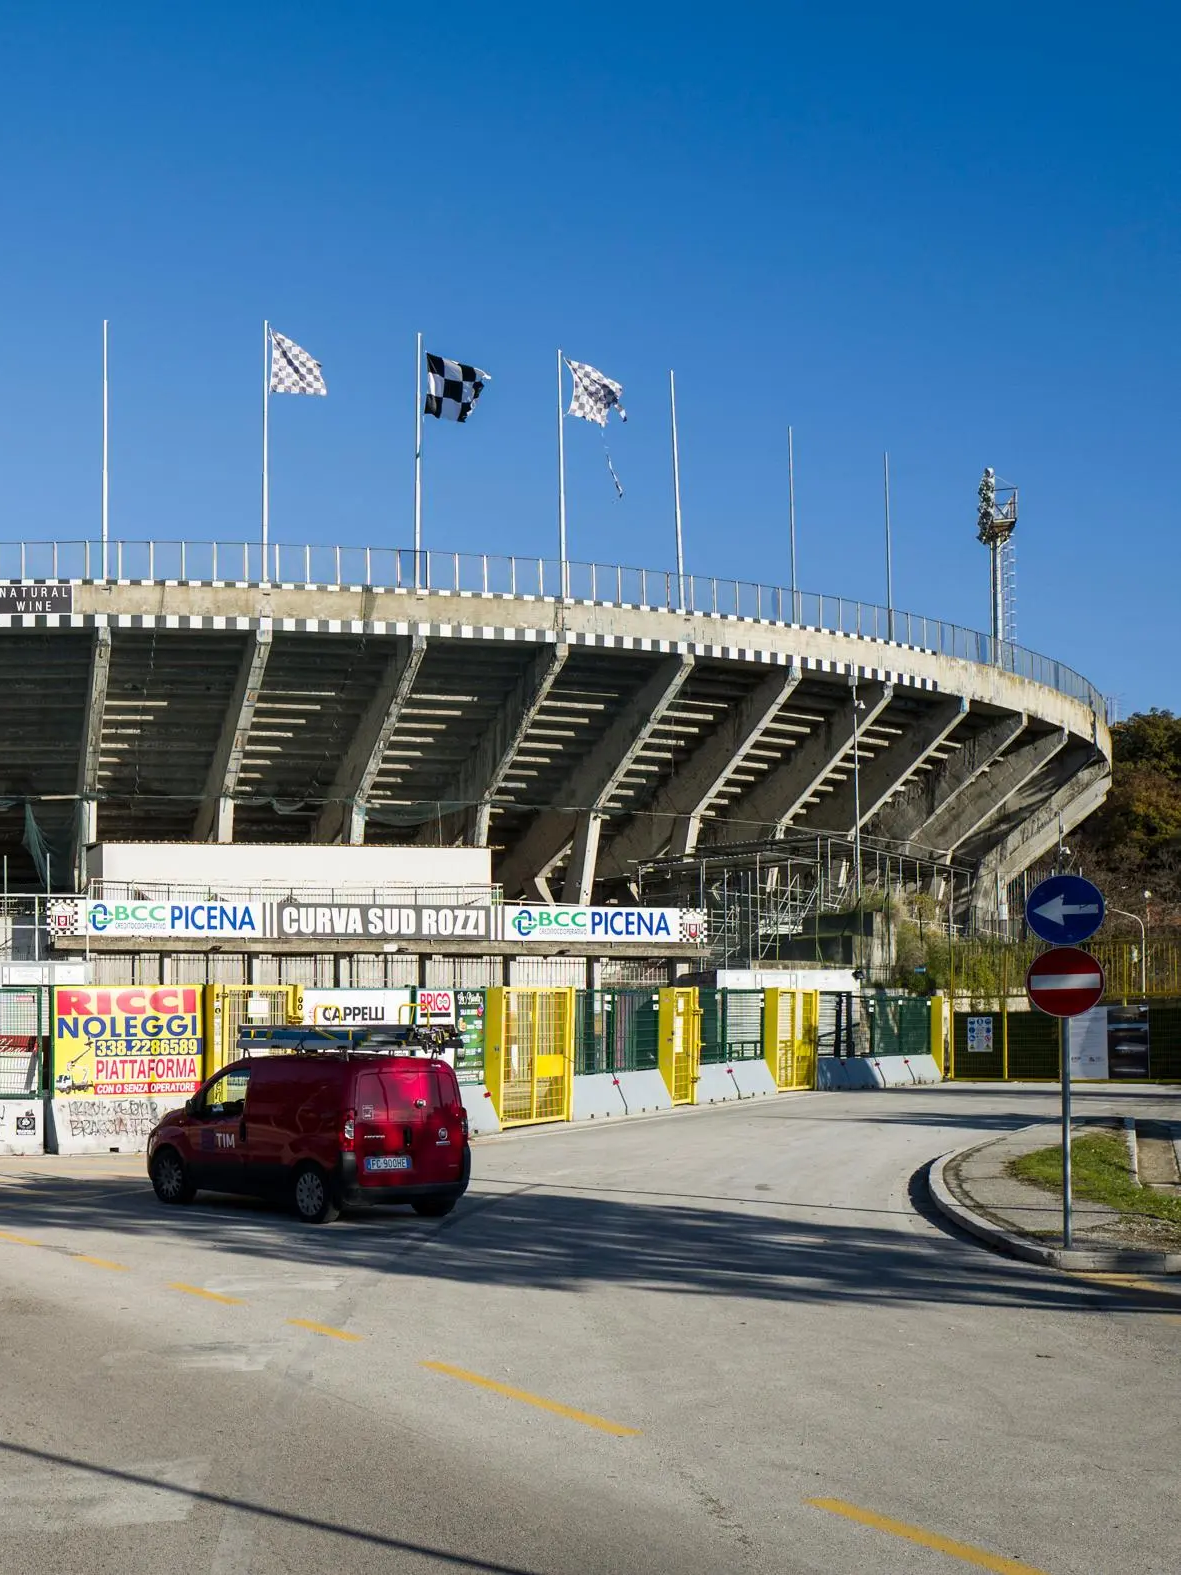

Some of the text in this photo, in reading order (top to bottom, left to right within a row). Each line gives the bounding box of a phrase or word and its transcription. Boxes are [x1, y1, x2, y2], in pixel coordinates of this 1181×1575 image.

[0, 587, 68, 598] NATURAL
[16, 600, 52, 612] WINE
[114, 905, 256, 931] BCC PICENA
[282, 906, 486, 936] CURVA SUD ROZZI
[538, 911, 671, 936] BCC PICENA
[57, 989, 197, 1016] RICCI
[420, 992, 451, 1012] BRICO
[322, 1006, 385, 1021] CAPPELLI
[57, 1015, 197, 1039] NOLEGGI
[96, 1038, 198, 1056] 338.2286589
[95, 1058, 197, 1080] PIATTAFORMA
[96, 1081, 196, 1093] CON O SENZA OPERATORE
[216, 1133, 236, 1149] TIM
